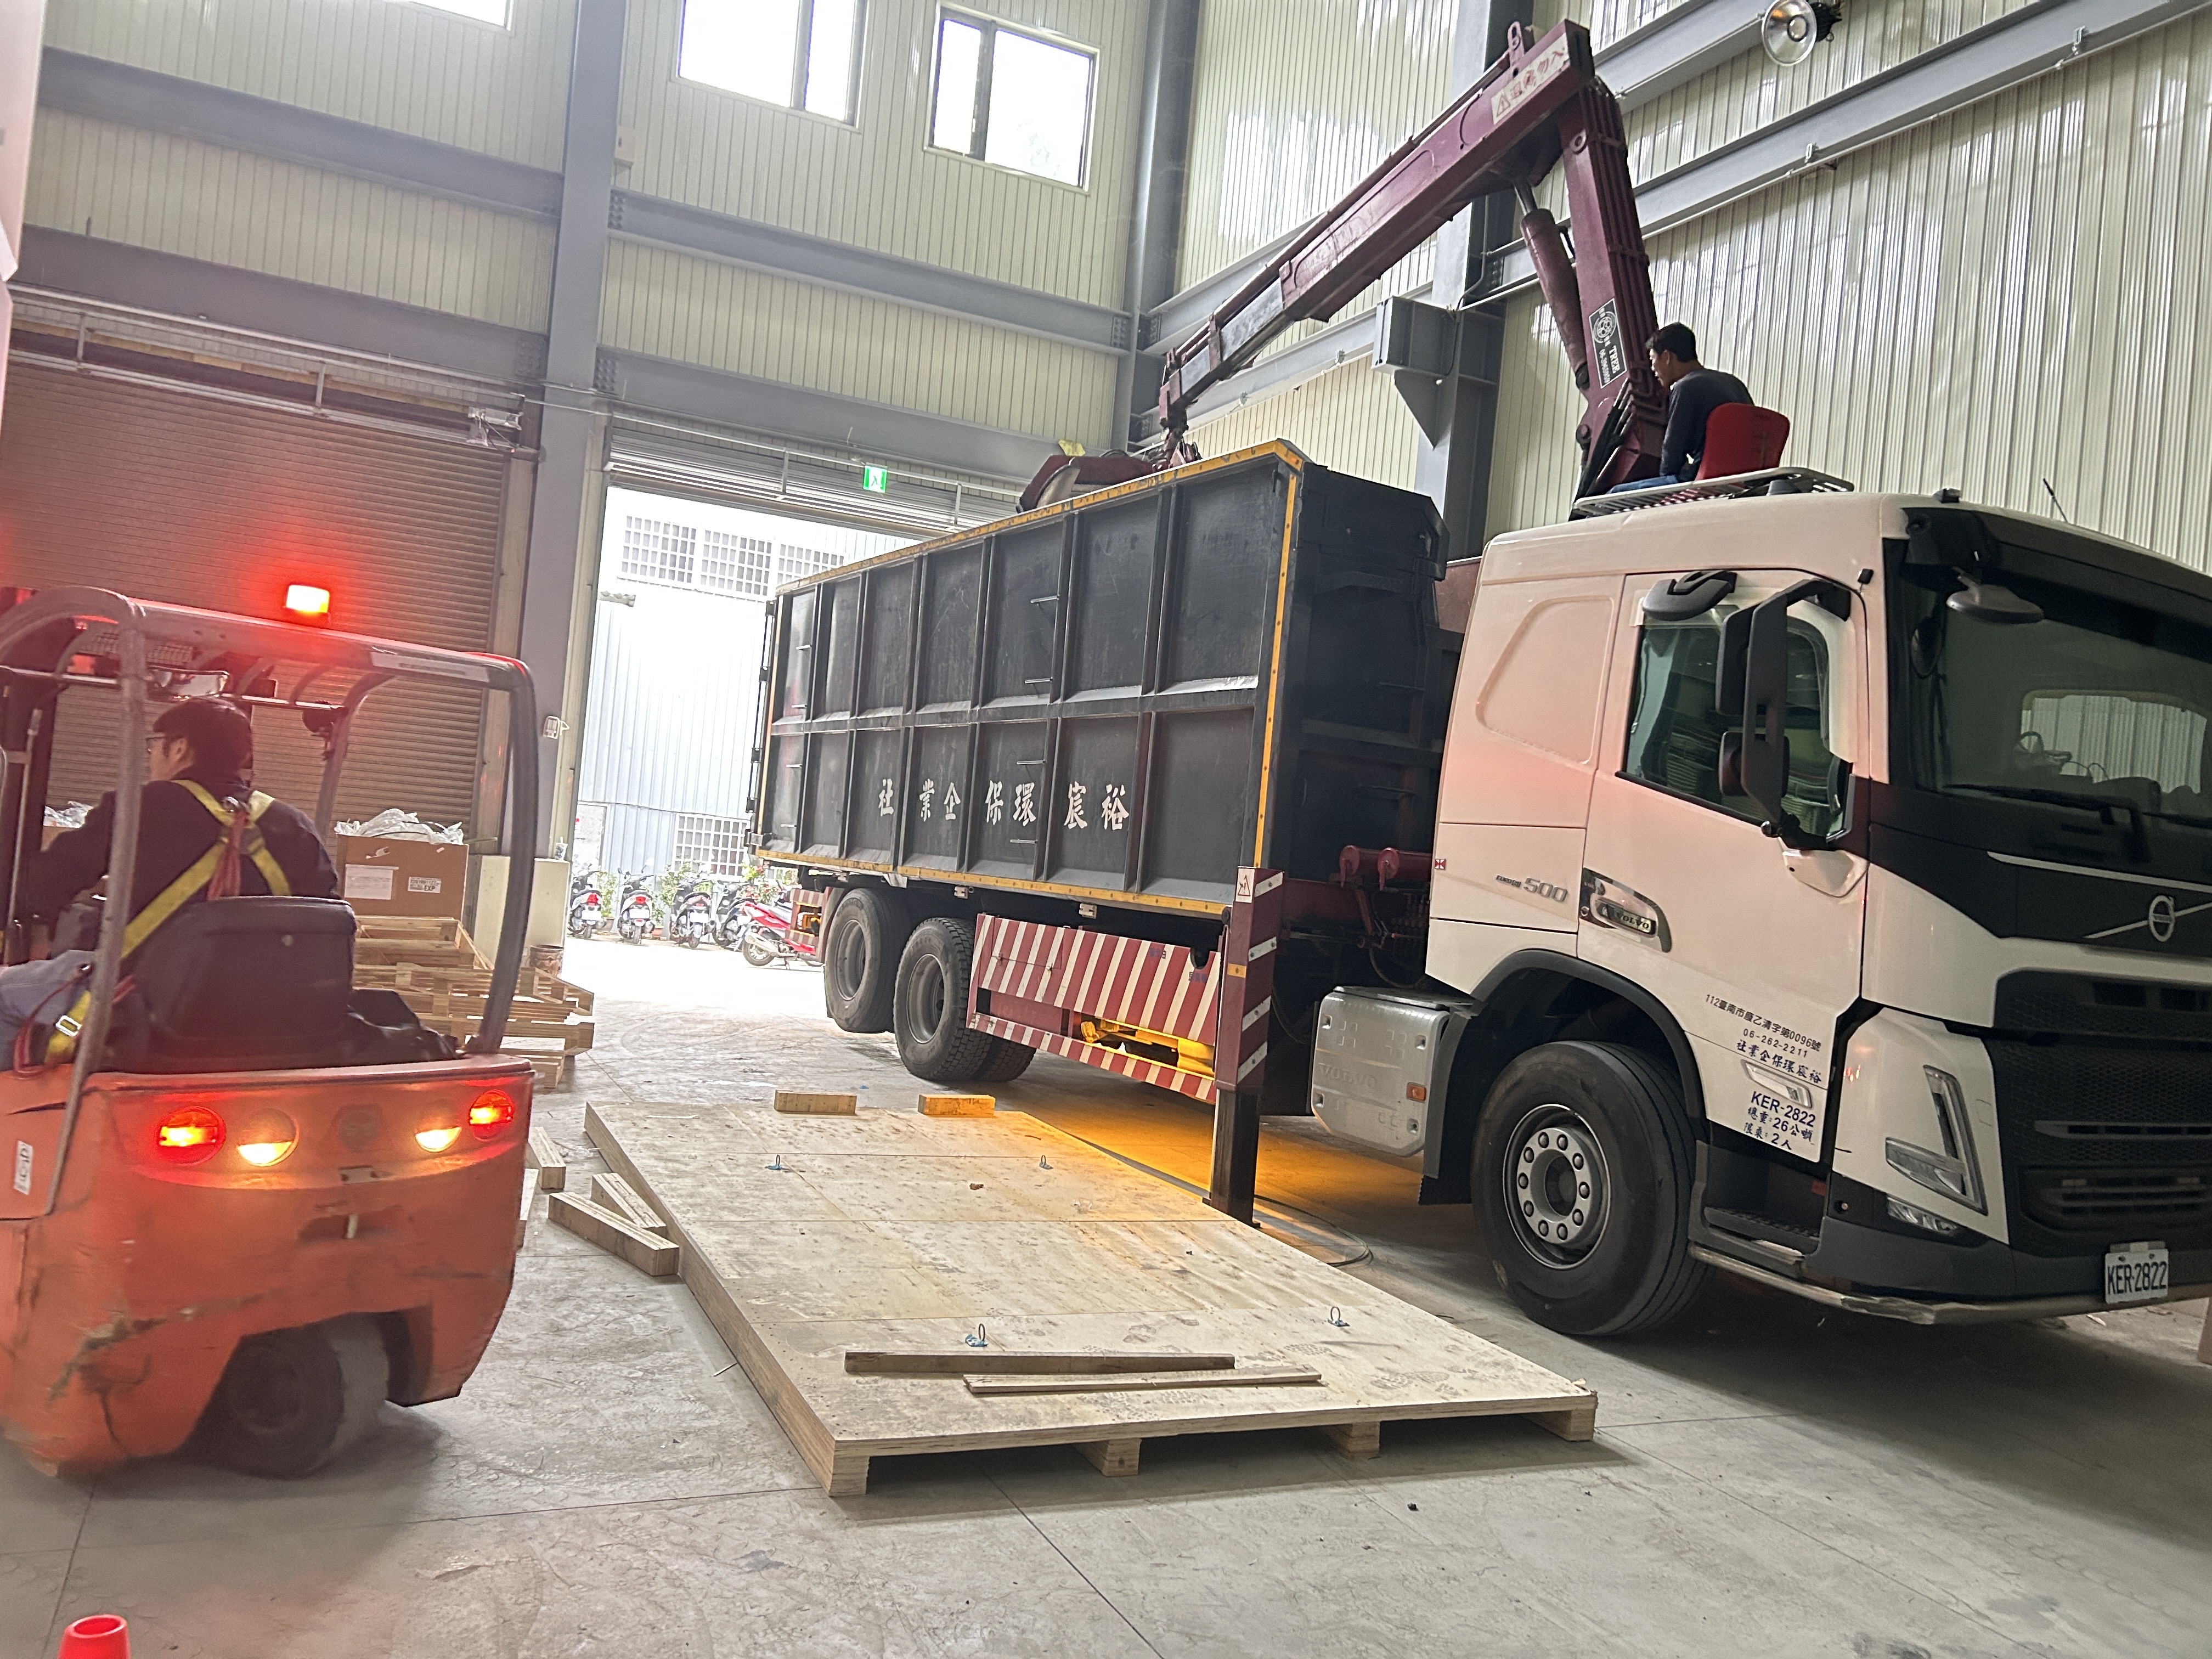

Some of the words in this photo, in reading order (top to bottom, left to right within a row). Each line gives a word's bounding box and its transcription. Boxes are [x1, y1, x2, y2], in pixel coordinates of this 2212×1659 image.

[1609, 345, 1621, 374] TREE
[1523, 877, 1568, 902] 500
[1743, 1028, 1808, 1058] 06-262-2211
[1751, 1091, 1816, 1128] KER-2822
[2107, 1261, 2167, 1295] KER-2822
